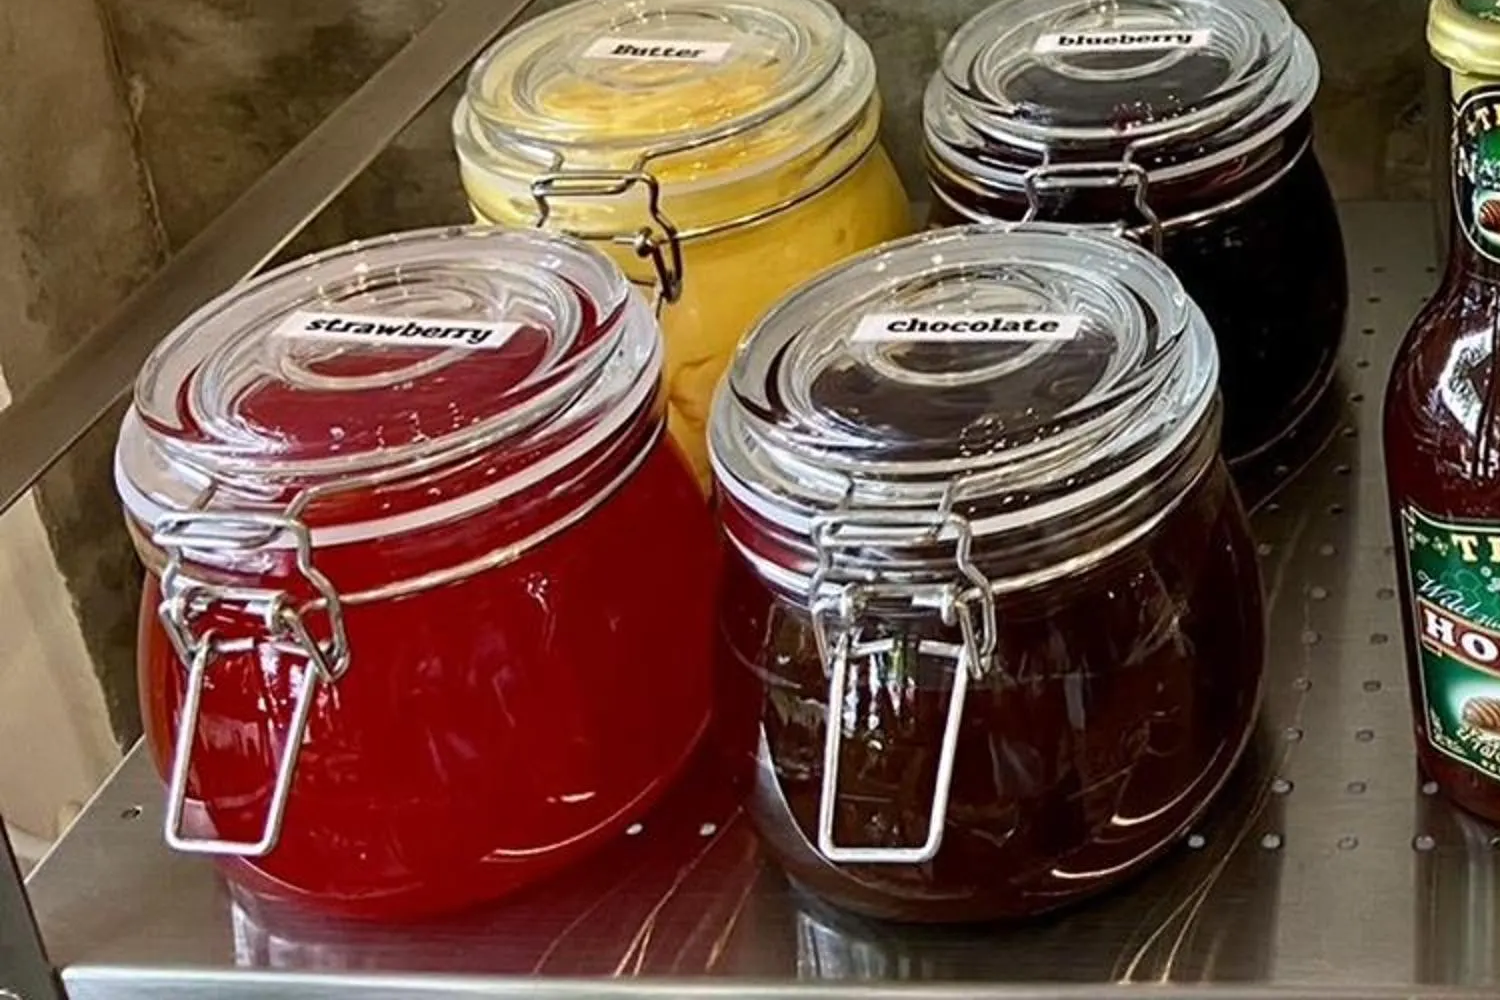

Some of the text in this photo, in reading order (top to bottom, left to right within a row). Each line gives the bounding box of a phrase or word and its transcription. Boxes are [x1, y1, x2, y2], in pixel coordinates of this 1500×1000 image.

[1057, 33, 1193, 46] blueberry
[609, 43, 706, 60] Butter
[305, 317, 493, 345] strawberry
[887, 317, 1060, 334] chocolate
